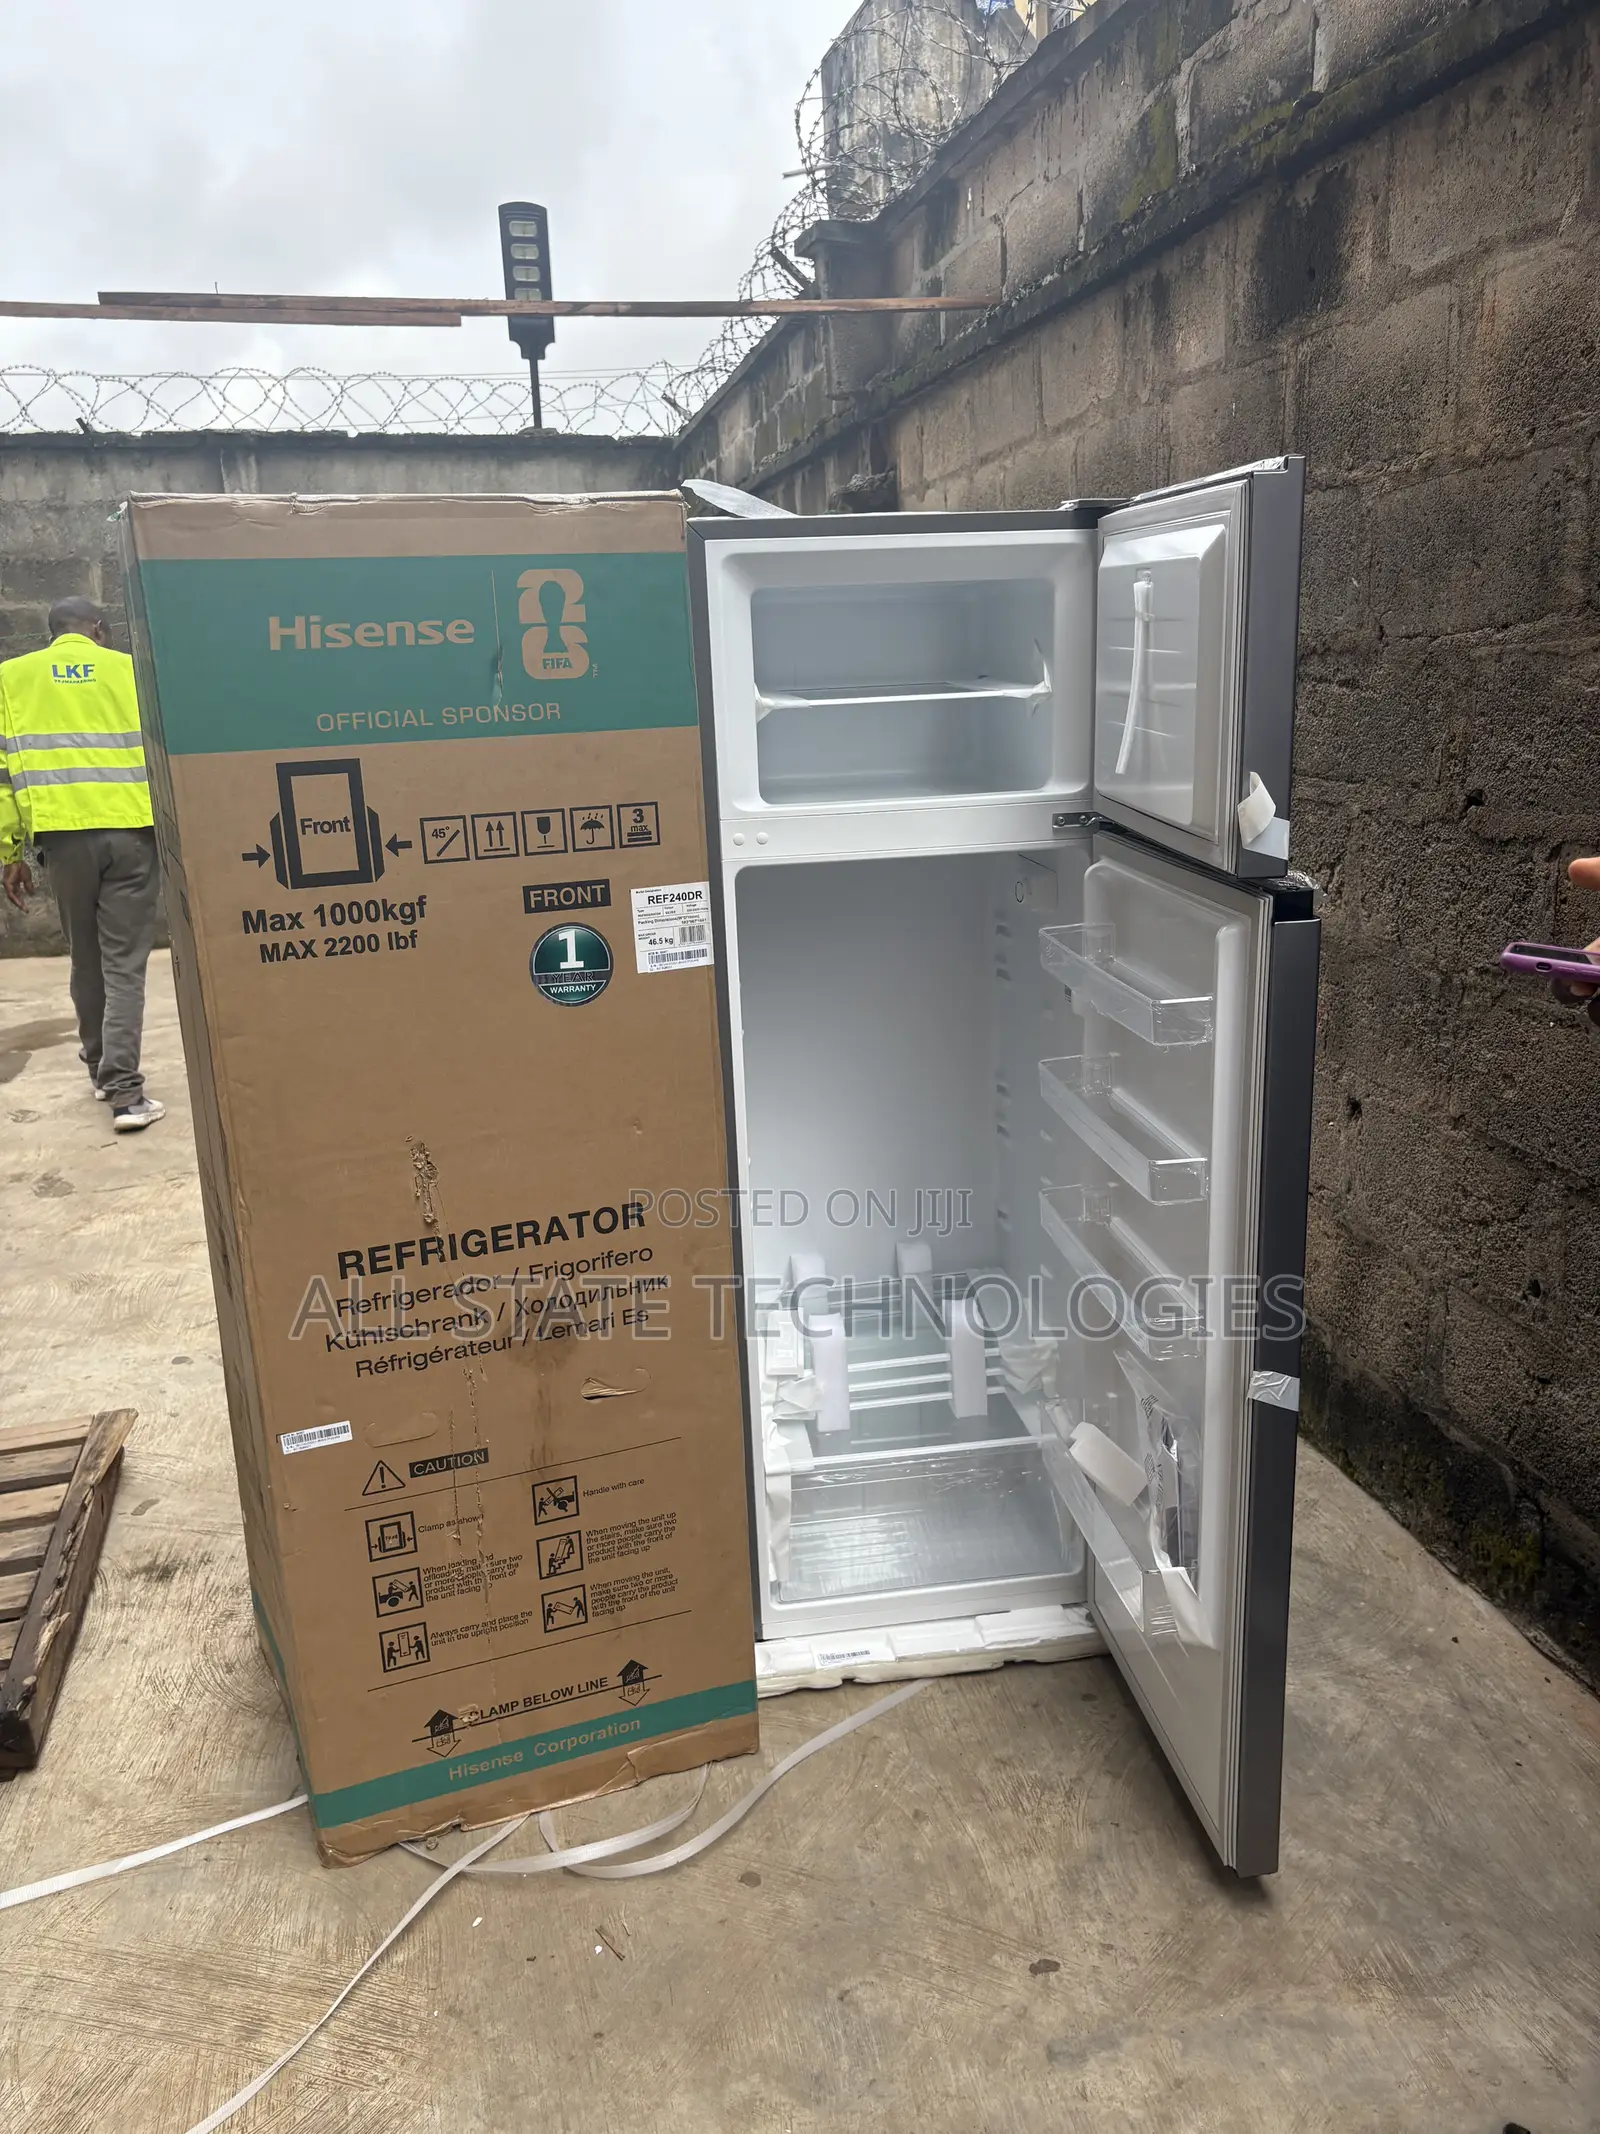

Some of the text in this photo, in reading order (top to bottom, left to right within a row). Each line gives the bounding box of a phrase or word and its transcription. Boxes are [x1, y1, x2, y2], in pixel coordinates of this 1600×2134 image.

[269, 615, 475, 650] Hisense
[52, 664, 95, 679] LKF
[542, 657, 573, 670] FIFA
[316, 703, 561, 732] OFFICIAL SPONSOR
[300, 816, 351, 836] Front
[633, 808, 645, 823] 3
[630, 824, 648, 832] max
[530, 885, 605, 908] FRONT
[647, 890, 703, 905] REF240DR
[242, 895, 427, 934] Max 1000kgf
[260, 930, 418, 963] MAX 2200 lbf
[558, 929, 585, 969] 1
[664, 937, 674, 945] kg
[552, 971, 594, 983] YEAR
[550, 984, 597, 994] WARRANTY
[337, 1202, 646, 1280] REFRIGERATOR
[336, 1275, 501, 1317] Refrigerador
[529, 1248, 653, 1282] Frigorifero
[325, 1308, 489, 1352] Kühlschrank
[515, 1275, 669, 1317] Холодильник
[355, 1335, 514, 1378] Réfrigérateur
[538, 1312, 615, 1341] Lemari
[622, 1308, 650, 1325] Es
[414, 1452, 485, 1475] CAUTION
[583, 1479, 645, 1497] Handle with care
[418, 1523, 444, 1533] Clamp
[586, 1527, 608, 1537] When
[610, 1521, 636, 1531] moving
[651, 1514, 665, 1522] unit
[596, 1540, 616, 1549] more
[618, 1533, 642, 1544] people
[644, 1529, 663, 1538] carry
[664, 1525, 675, 1533] the
[600, 1532, 622, 1542] stairs,
[624, 1527, 644, 1535] make
[646, 1522, 662, 1530] sure
[587, 1547, 615, 1558] product
[617, 1542, 632, 1550] with
[647, 1535, 663, 1543] front
[602, 1553, 615, 1561] unit
[617, 1547, 639, 1557] facing
[422, 1565, 447, 1575] When
[448, 1558, 477, 1569] loading
[490, 1558, 507, 1567] sure
[509, 1554, 522, 1562] two
[507, 1562, 519, 1570] the
[425, 1584, 455, 1596] product
[456, 1578, 473, 1588] with
[489, 1573, 507, 1582] front
[590, 1582, 612, 1591] When
[614, 1574, 640, 1585] moving
[655, 1567, 670, 1575] unit,
[590, 1588, 611, 1598] make
[613, 1584, 629, 1592] sure
[654, 1574, 673, 1582] more
[441, 1590, 455, 1599] unit
[457, 1585, 481, 1595] facing
[591, 1594, 616, 1605] people
[617, 1589, 637, 1598] carry
[651, 1578, 678, 1590] product
[591, 1602, 606, 1610] with
[622, 1594, 638, 1603] front
[648, 1589, 660, 1597] the
[662, 1586, 676, 1594] unit
[592, 1604, 625, 1617] facing up
[430, 1627, 458, 1640] Always
[460, 1623, 479, 1633] carry
[482, 1619, 496, 1627] and
[498, 1614, 518, 1624] place
[431, 1638, 446, 1646] unit
[471, 1626, 498, 1637] upright
[499, 1619, 528, 1631] position
[523, 1685, 574, 1708] BELOW
[578, 1677, 608, 1693] LINE
[450, 1719, 641, 1781] Hisense Corporation
